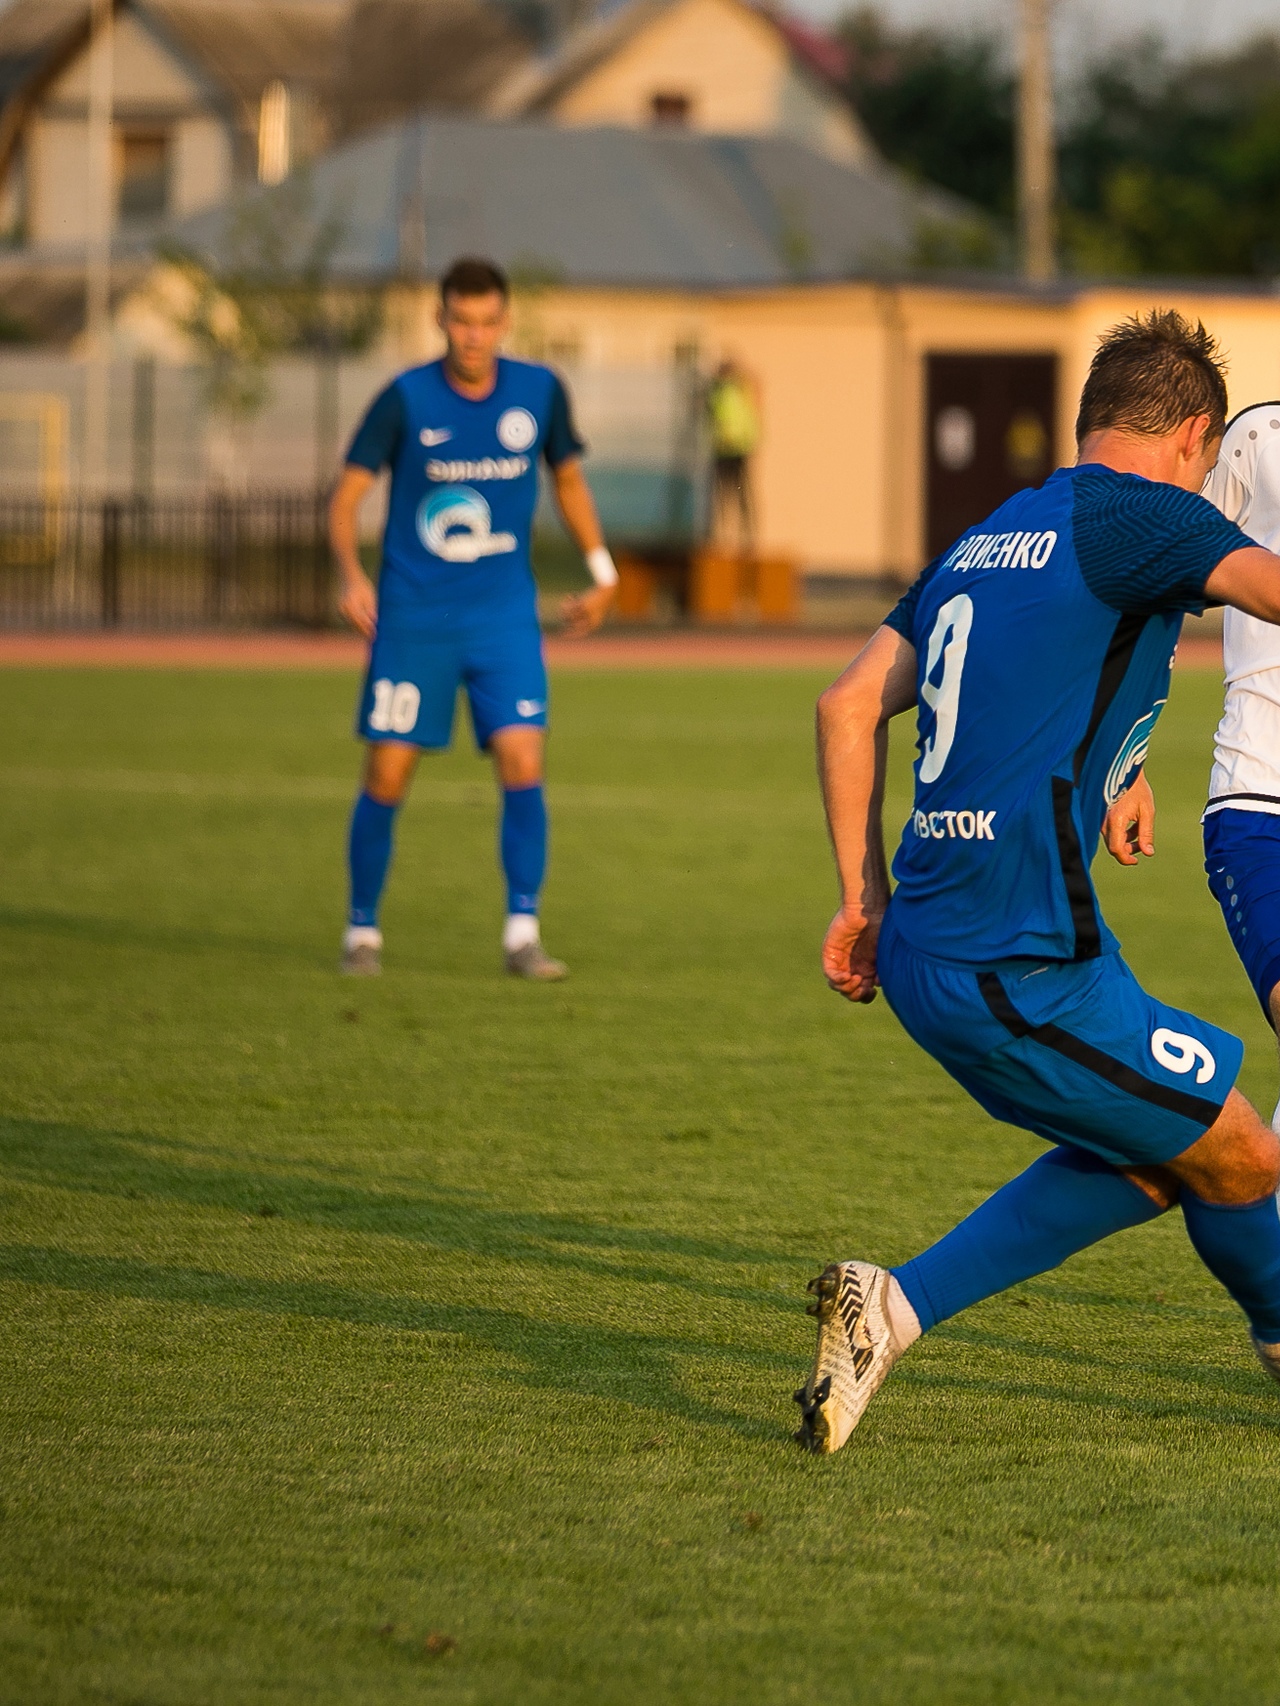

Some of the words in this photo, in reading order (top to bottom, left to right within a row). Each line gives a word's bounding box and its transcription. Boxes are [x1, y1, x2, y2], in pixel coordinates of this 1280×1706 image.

[942, 530, 1058, 573] РДИЕНКО
[369, 678, 421, 733] 10
[920, 593, 974, 784] 9
[1151, 1027, 1217, 1084] 9
